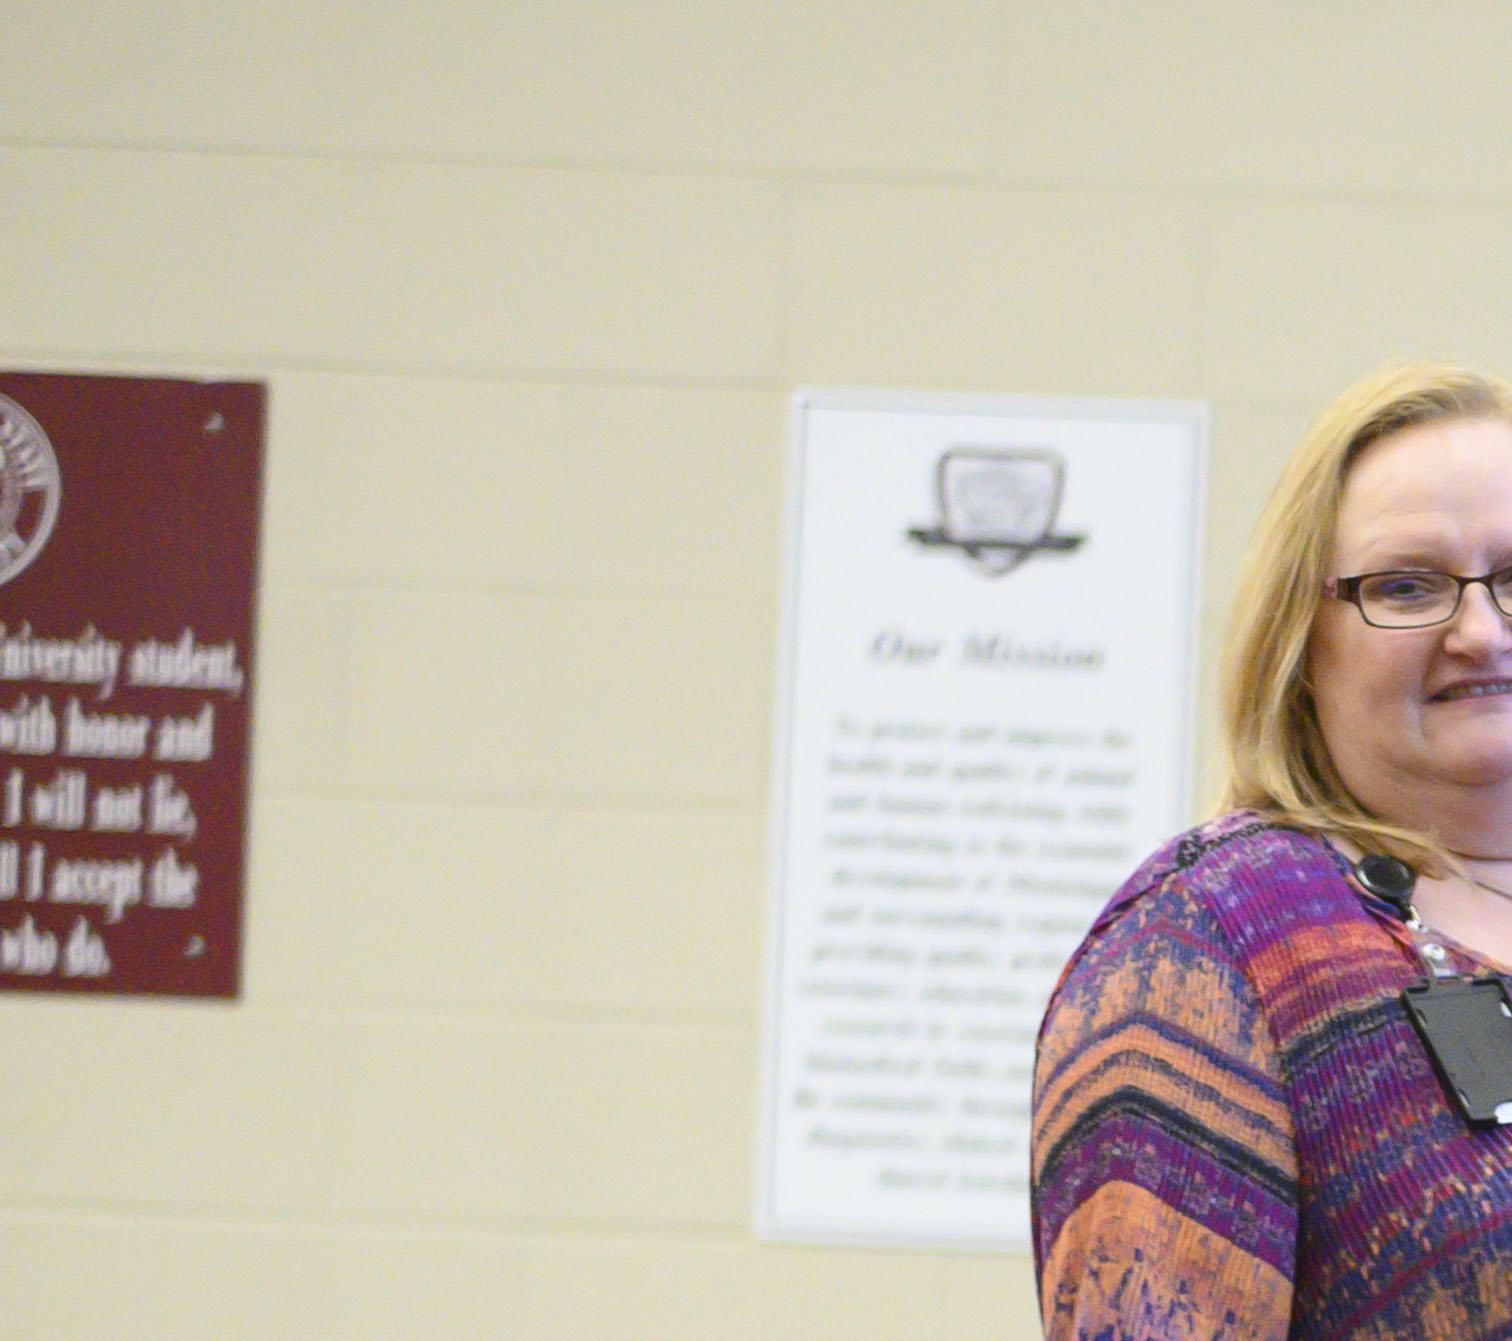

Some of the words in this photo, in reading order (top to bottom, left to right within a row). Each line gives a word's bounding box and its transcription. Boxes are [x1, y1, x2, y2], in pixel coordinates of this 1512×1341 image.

[961, 633, 1106, 673] Mission
[64, 695, 150, 759] honor
[154, 702, 214, 763] and
[31, 767, 87, 830] will
[92, 782, 143, 834] not
[52, 857, 143, 925] accept
[150, 847, 199, 909] the
